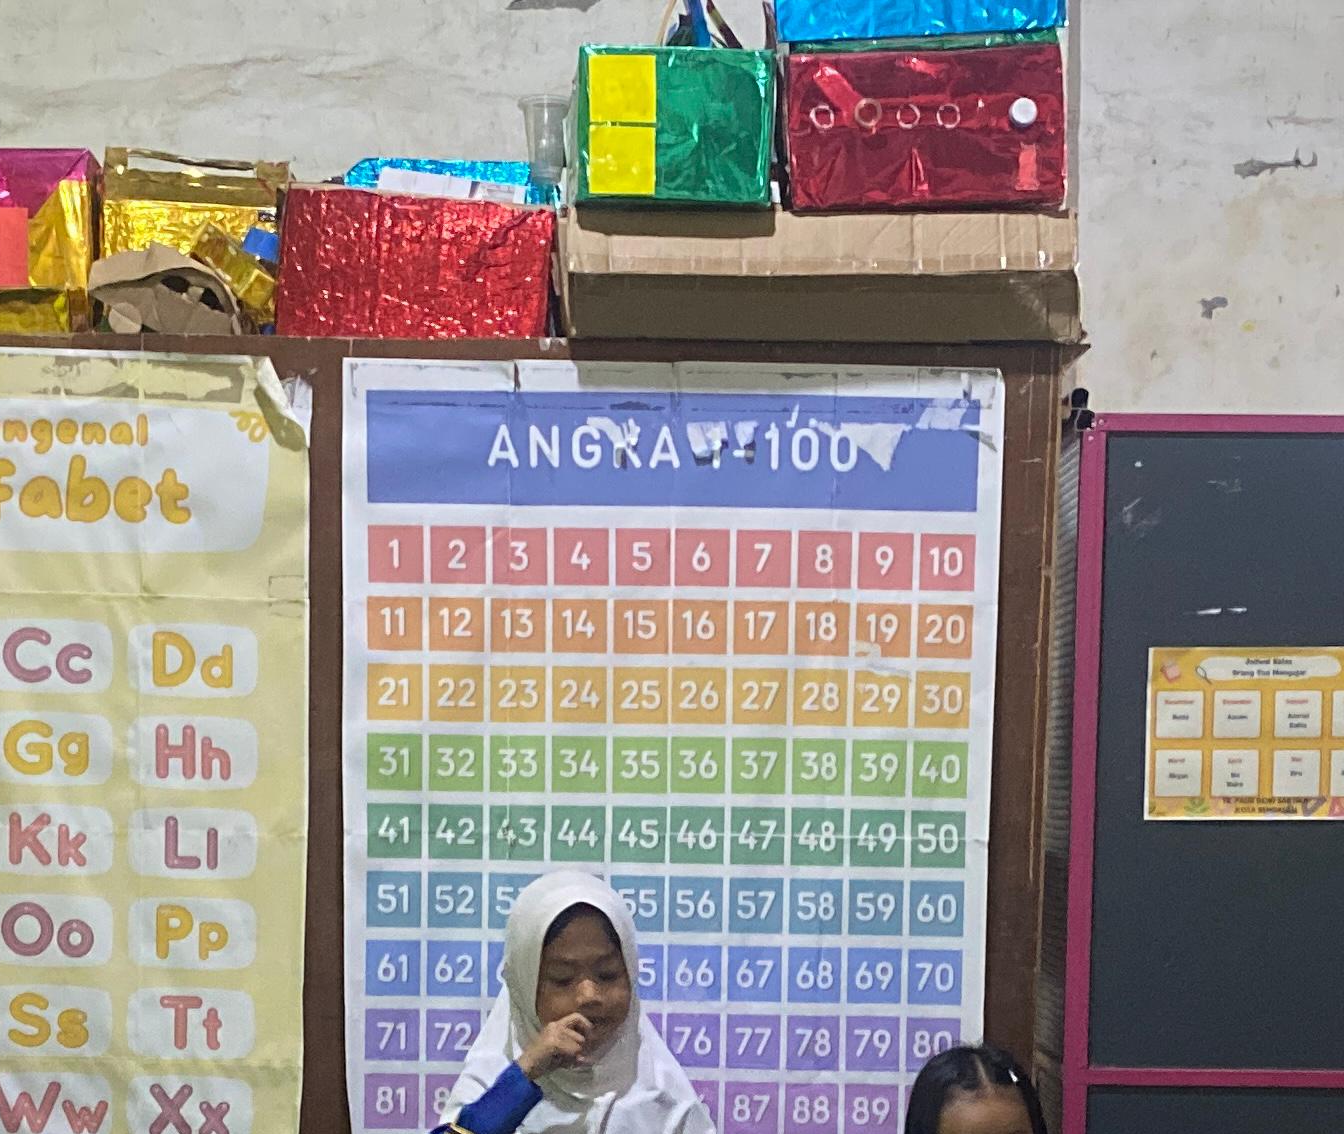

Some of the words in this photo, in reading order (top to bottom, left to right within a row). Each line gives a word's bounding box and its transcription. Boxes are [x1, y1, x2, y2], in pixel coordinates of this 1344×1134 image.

[388, 538, 399, 569] 1
[447, 538, 467, 569] 2
[509, 541, 529, 571] 3
[570, 541, 591, 571] 4
[632, 541, 652, 571] 5
[692, 541, 711, 572] 6
[754, 543, 772, 572] 7
[814, 543, 834, 574] 8
[875, 545, 894, 575] 9
[929, 546, 963, 577] 10
[380, 606, 405, 636] 11
[439, 607, 472, 637] 12
[500, 608, 533, 639] 13
[561, 608, 595, 638] 14
[623, 609, 657, 640] 15
[682, 610, 715, 640] 16
[744, 610, 776, 640] 17
[805, 611, 837, 642] 18
[866, 613, 898, 643] 19
[923, 614, 965, 644] 20
[2, 627, 93, 684] Cc
[152, 632, 234, 689] Dd
[378, 677, 409, 706] 21
[436, 677, 476, 707] 22
[498, 678, 539, 708] 23
[559, 678, 600, 708] 24
[620, 679, 661, 710] 25
[678, 680, 719, 710] 26
[740, 680, 779, 710] 27
[801, 681, 839, 712] 28
[859, 683, 901, 713] 29
[922, 684, 963, 714] 30
[3, 720, 90, 777] Gg
[155, 725, 232, 781] Hh
[378, 746, 410, 776] 31
[437, 747, 475, 778] 32
[498, 747, 538, 779] 33
[559, 749, 599, 778] 34
[620, 749, 660, 779] 35
[678, 749, 718, 779] 36
[740, 750, 778, 780] 37
[800, 751, 837, 781] 38
[859, 752, 899, 782] 39
[919, 753, 961, 784] 40
[8, 812, 88, 868] Kk
[164, 816, 218, 871] Ll
[378, 815, 409, 844] 41
[435, 817, 475, 845] 42
[557, 818, 598, 848] 44
[618, 818, 659, 849] 45
[677, 821, 717, 849] 46
[739, 821, 776, 849] 47
[798, 823, 837, 851] 48
[857, 824, 898, 852] 49
[917, 823, 959, 854] 50
[377, 883, 409, 913] 51
[435, 884, 475, 914] 52
[676, 889, 716, 919] 56
[736, 890, 776, 920] 57
[796, 891, 835, 921] 58
[855, 892, 896, 921] 59
[916, 893, 957, 923] 60
[1, 901, 95, 958] Oo
[155, 905, 229, 961] Pp
[377, 953, 408, 982] 61
[434, 953, 474, 983] 62
[674, 958, 714, 987] 66
[736, 959, 774, 989] 67
[797, 961, 833, 988] 68
[855, 961, 894, 991] 69
[915, 962, 954, 992] 70
[8, 993, 89, 1049] Ss
[159, 995, 224, 1051] Tt
[376, 1021, 406, 1050] 71
[434, 1023, 473, 1050] 72
[674, 1026, 712, 1055] 76
[735, 1027, 772, 1056] 77
[795, 1027, 831, 1057] 78
[853, 1028, 891, 1058] 79
[912, 1030, 953, 1058] 80
[375, 1086, 406, 1114] 81
[732, 1094, 770, 1122] 87
[792, 1095, 830, 1124] 88
[851, 1096, 890, 1125] 89
